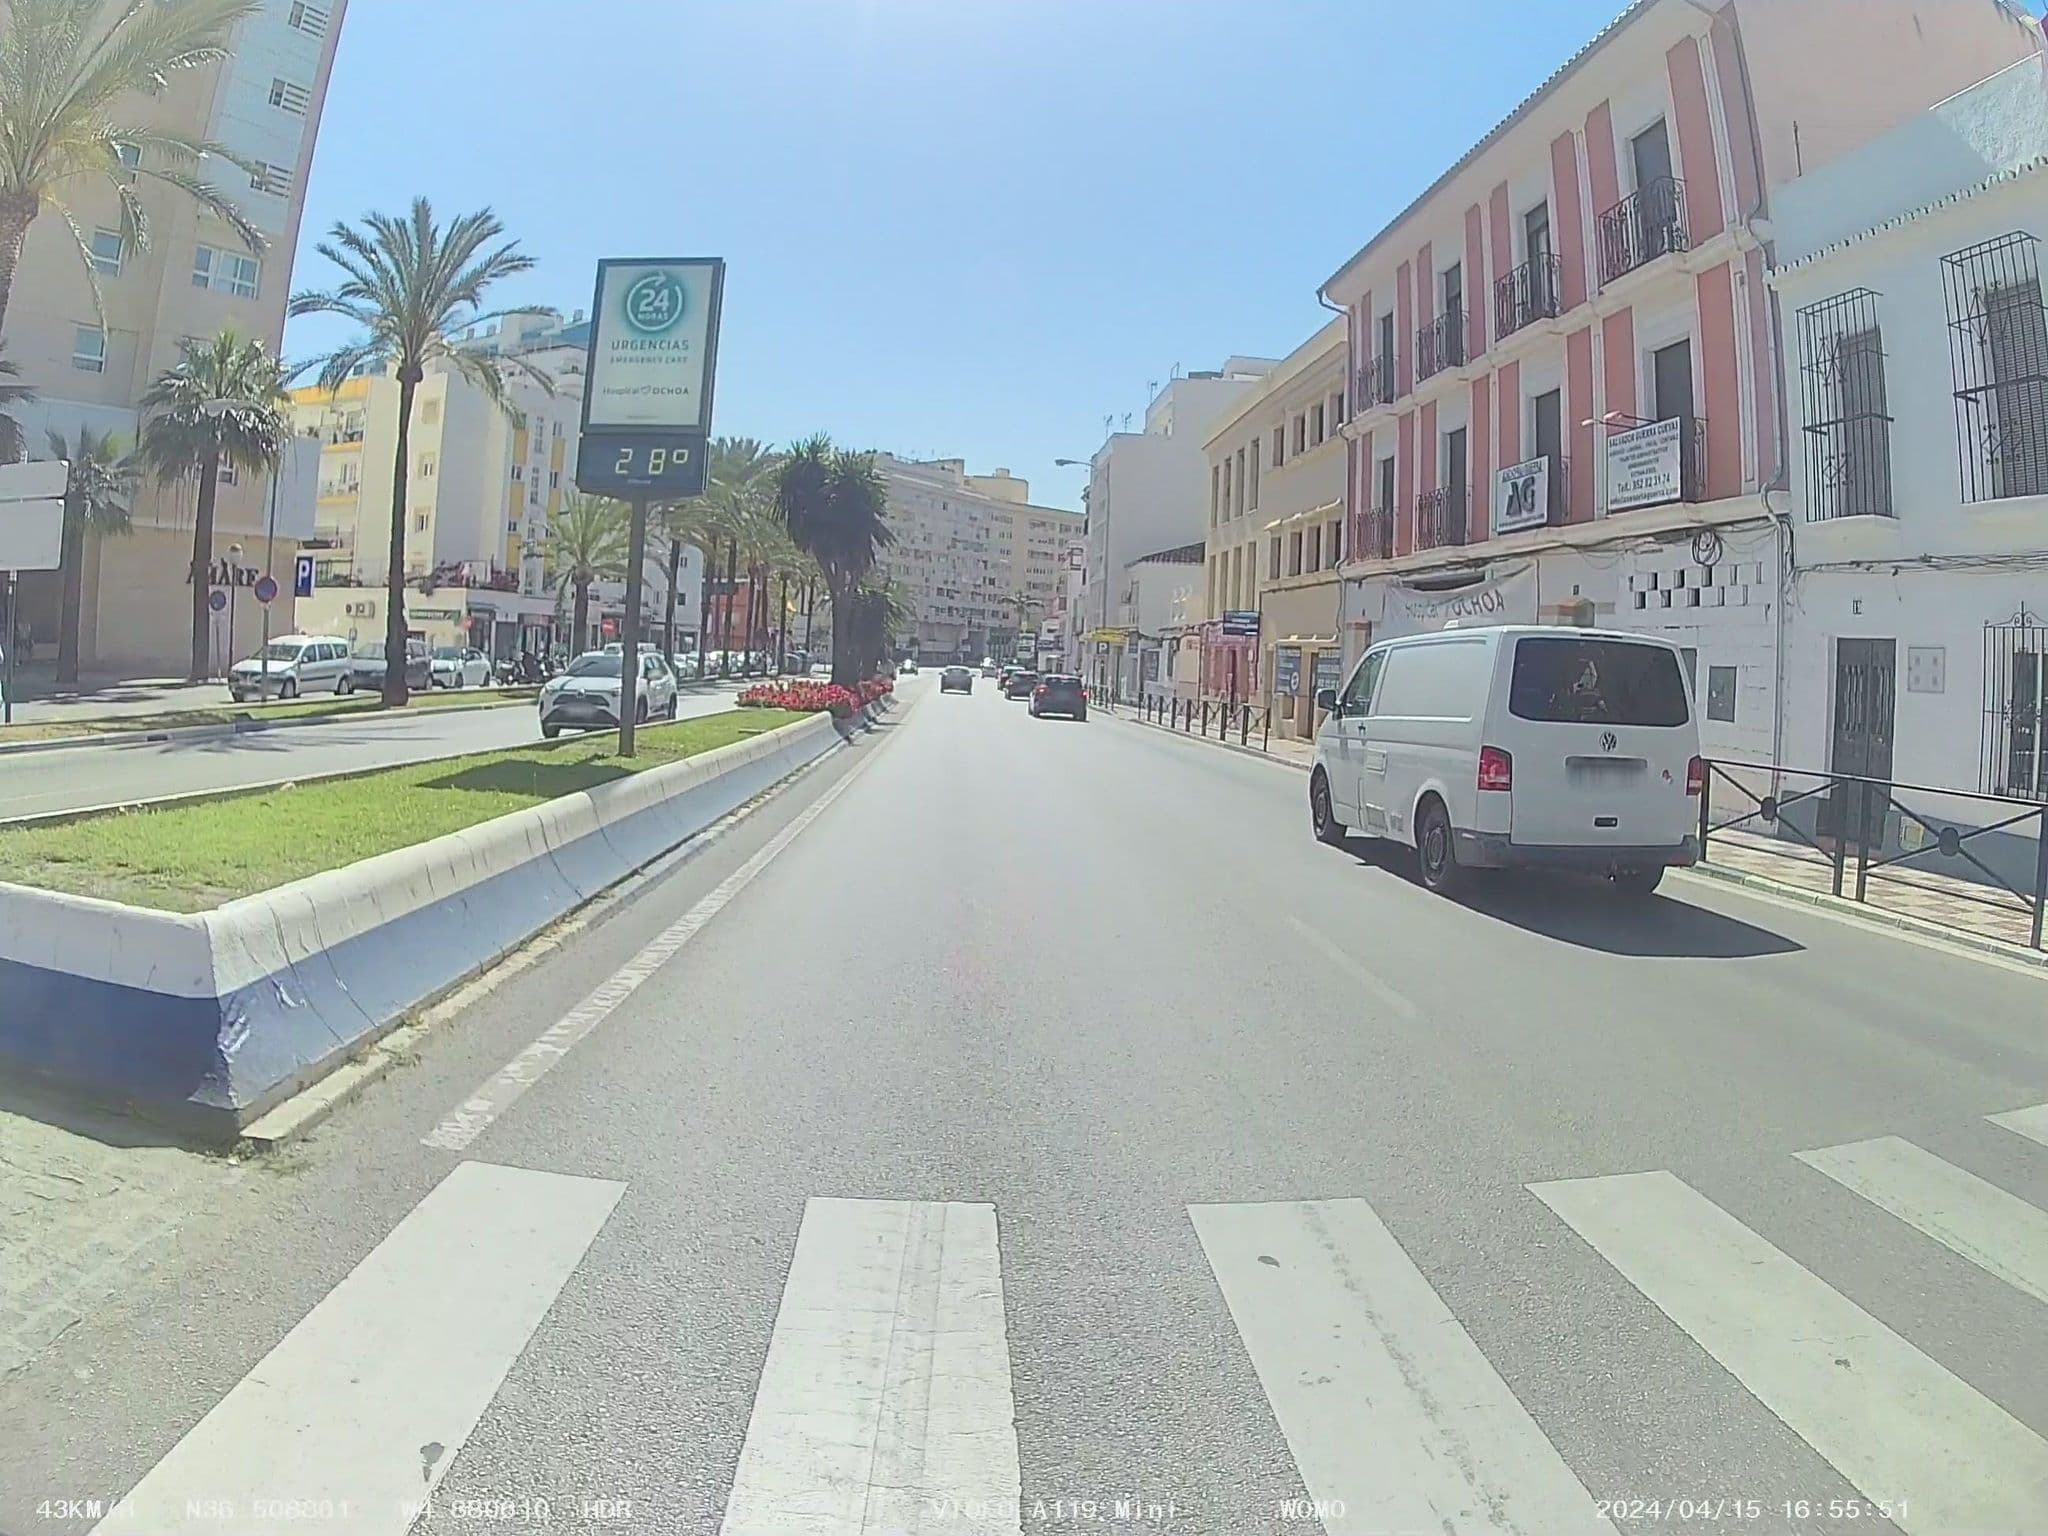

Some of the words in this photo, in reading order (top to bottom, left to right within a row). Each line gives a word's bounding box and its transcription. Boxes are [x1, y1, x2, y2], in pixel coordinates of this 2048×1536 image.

[640, 289, 669, 312] 24
[611, 339, 689, 351] URGENCIAS
[652, 386, 689, 395] OCHOA
